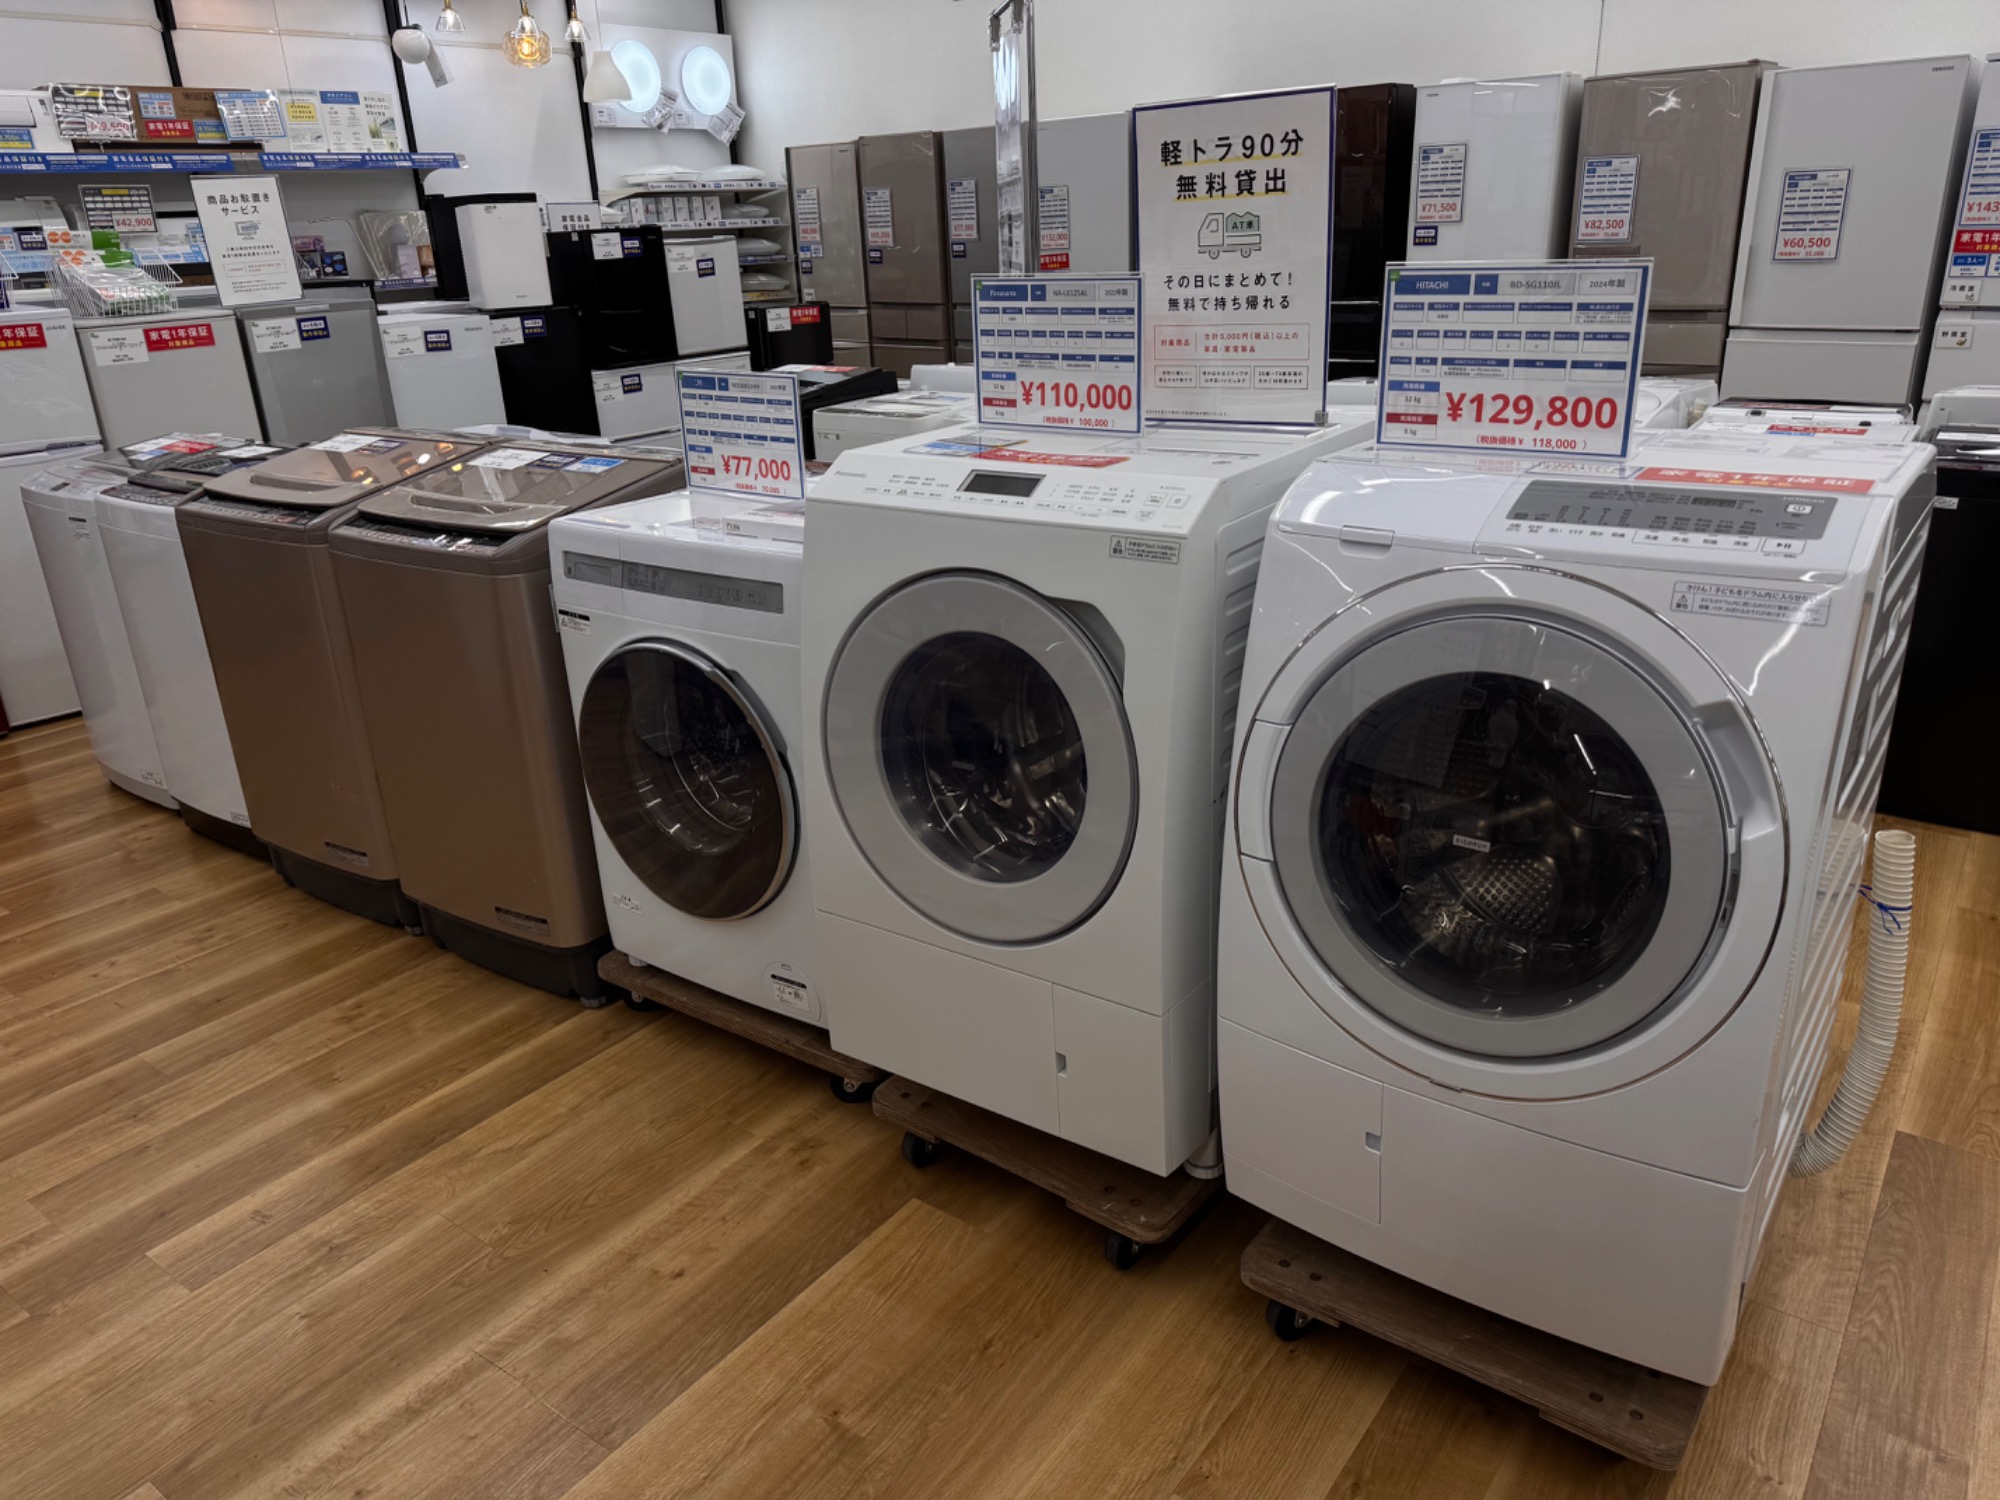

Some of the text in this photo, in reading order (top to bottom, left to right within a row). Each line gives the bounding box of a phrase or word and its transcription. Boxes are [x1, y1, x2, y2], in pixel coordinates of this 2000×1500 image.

[148, 121, 190, 131] 家電1年保証
[1160, 128, 1304, 167] 軽トラ90分
[1176, 167, 1287, 200] 無料貸出
[206, 193, 270, 205] 商品お取置き
[221, 205, 260, 216] サービス
[1421, 203, 1457, 213] ¥71,500
[114, 217, 153, 228] ¥42,900
[1584, 219, 1624, 230] ¥82,500
[1782, 237, 1831, 249] ¥60,500
[1163, 271, 1293, 289] その日にまとめて！
[1416, 281, 1449, 290] HITACHI
[1588, 279, 1626, 289] 2024年製
[1167, 295, 1291, 312] 無料で持ち帰れる
[149, 325, 209, 341] 家電1年保証
[1020, 381, 1132, 412] ¥110,000
[1404, 395, 1422, 404] 12 kg
[1445, 392, 1618, 431] ¥129,800
[1079, 418, 1109, 428] 100,000
[1532, 438, 1577, 450] 118,000
[721, 455, 791, 481] ¥77,000
[1658, 468, 1856, 487] 家電1年保証
[1687, 584, 1816, 603] きけん！子どもをドラム内に入らせな
